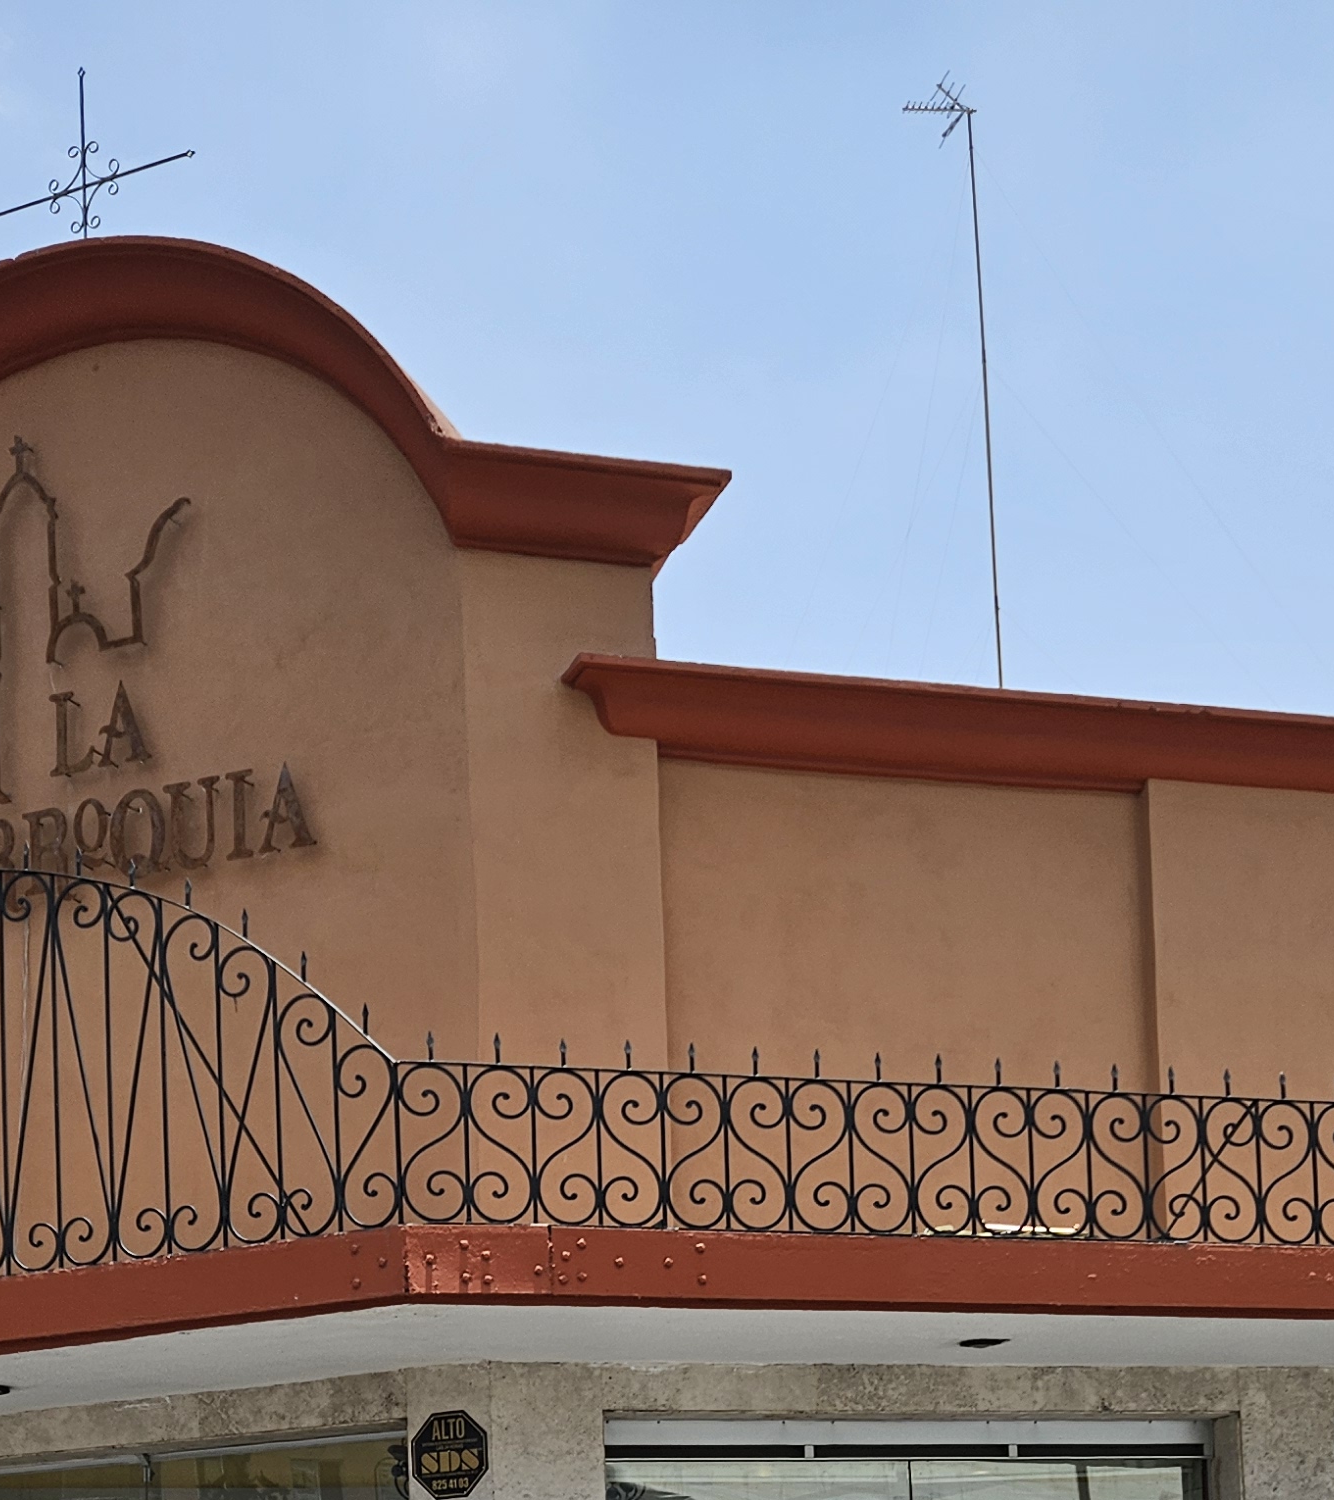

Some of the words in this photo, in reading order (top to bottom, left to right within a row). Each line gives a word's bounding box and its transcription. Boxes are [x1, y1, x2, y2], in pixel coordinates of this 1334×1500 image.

[48, 680, 153, 778] LA
[432, 1418, 465, 1441] ALTO
[421, 1448, 479, 1474] SDS
[432, 1479, 447, 1490] 825
[448, 1478, 457, 1489] 41
[458, 1477, 469, 1488] 03
